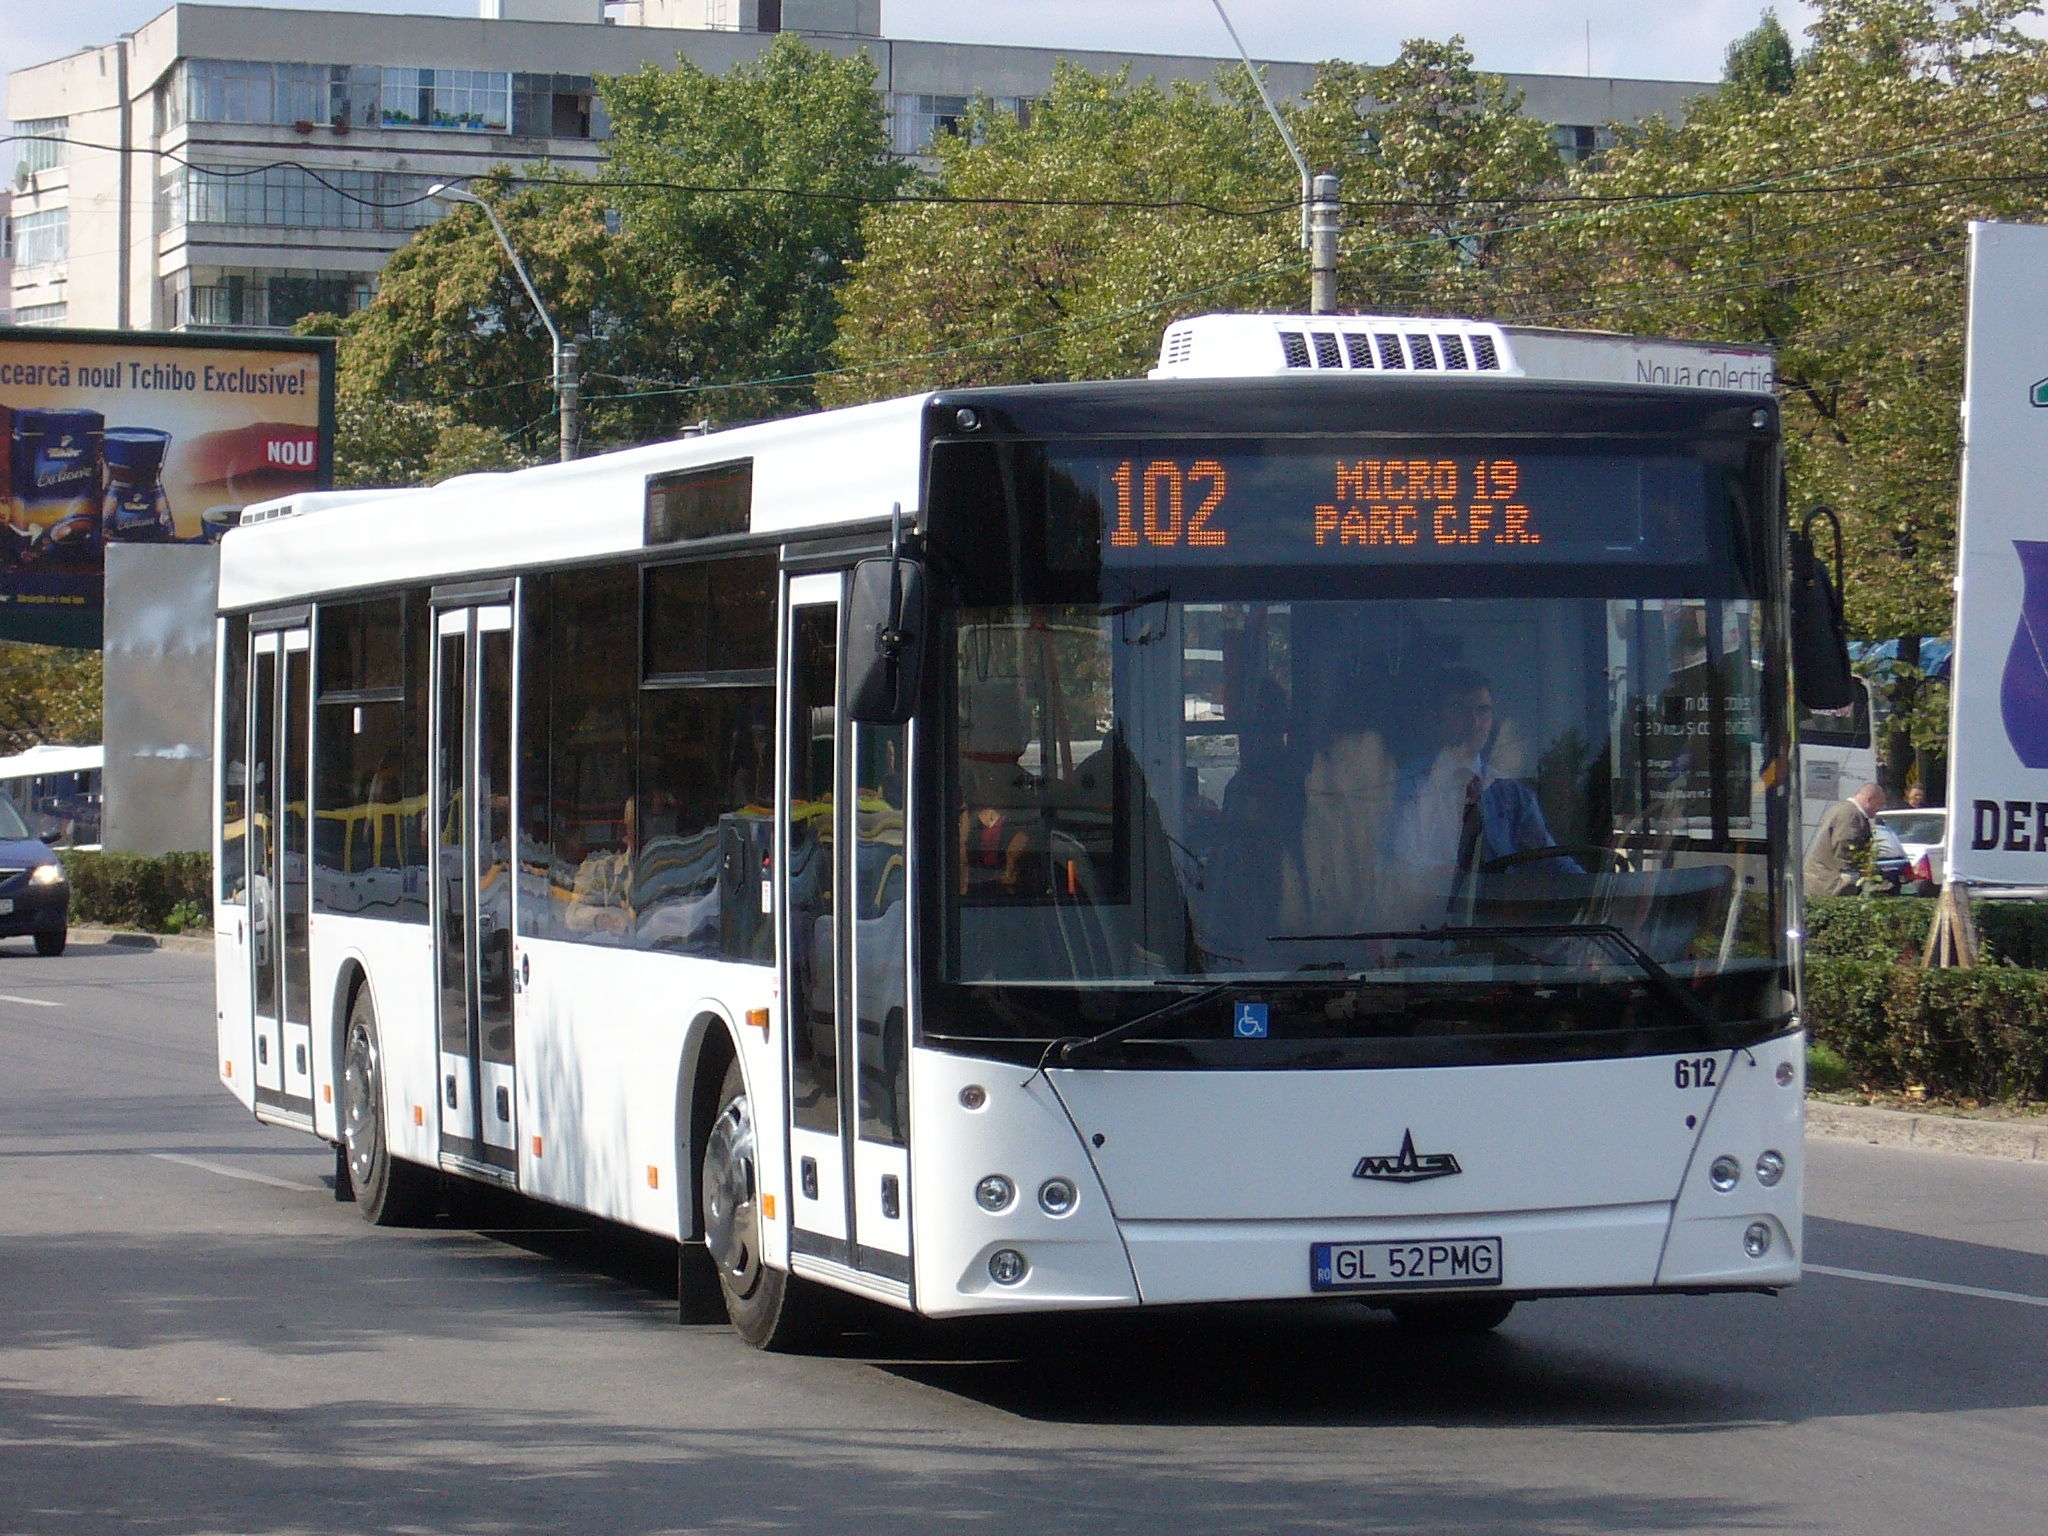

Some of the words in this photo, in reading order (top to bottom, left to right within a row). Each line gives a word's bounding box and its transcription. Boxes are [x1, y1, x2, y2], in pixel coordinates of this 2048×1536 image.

[1, 359, 71, 387] cearcă
[78, 361, 121, 389] noul
[129, 362, 196, 391] Tchibo
[204, 365, 305, 395] Exclusive!
[267, 441, 314, 466] NOU
[1336, 460, 1458, 501] MICRO
[1473, 460, 1519, 501] 19
[1110, 460, 1229, 547] 102
[1314, 505, 1418, 545] PARC
[1433, 505, 1541, 545] C.F.R.
[1675, 1057, 1716, 1089] 612
[1317, 1268, 1331, 1281] RO
[1336, 1249, 1376, 1279] GL
[1388, 1245, 1493, 1277] 52PMG
